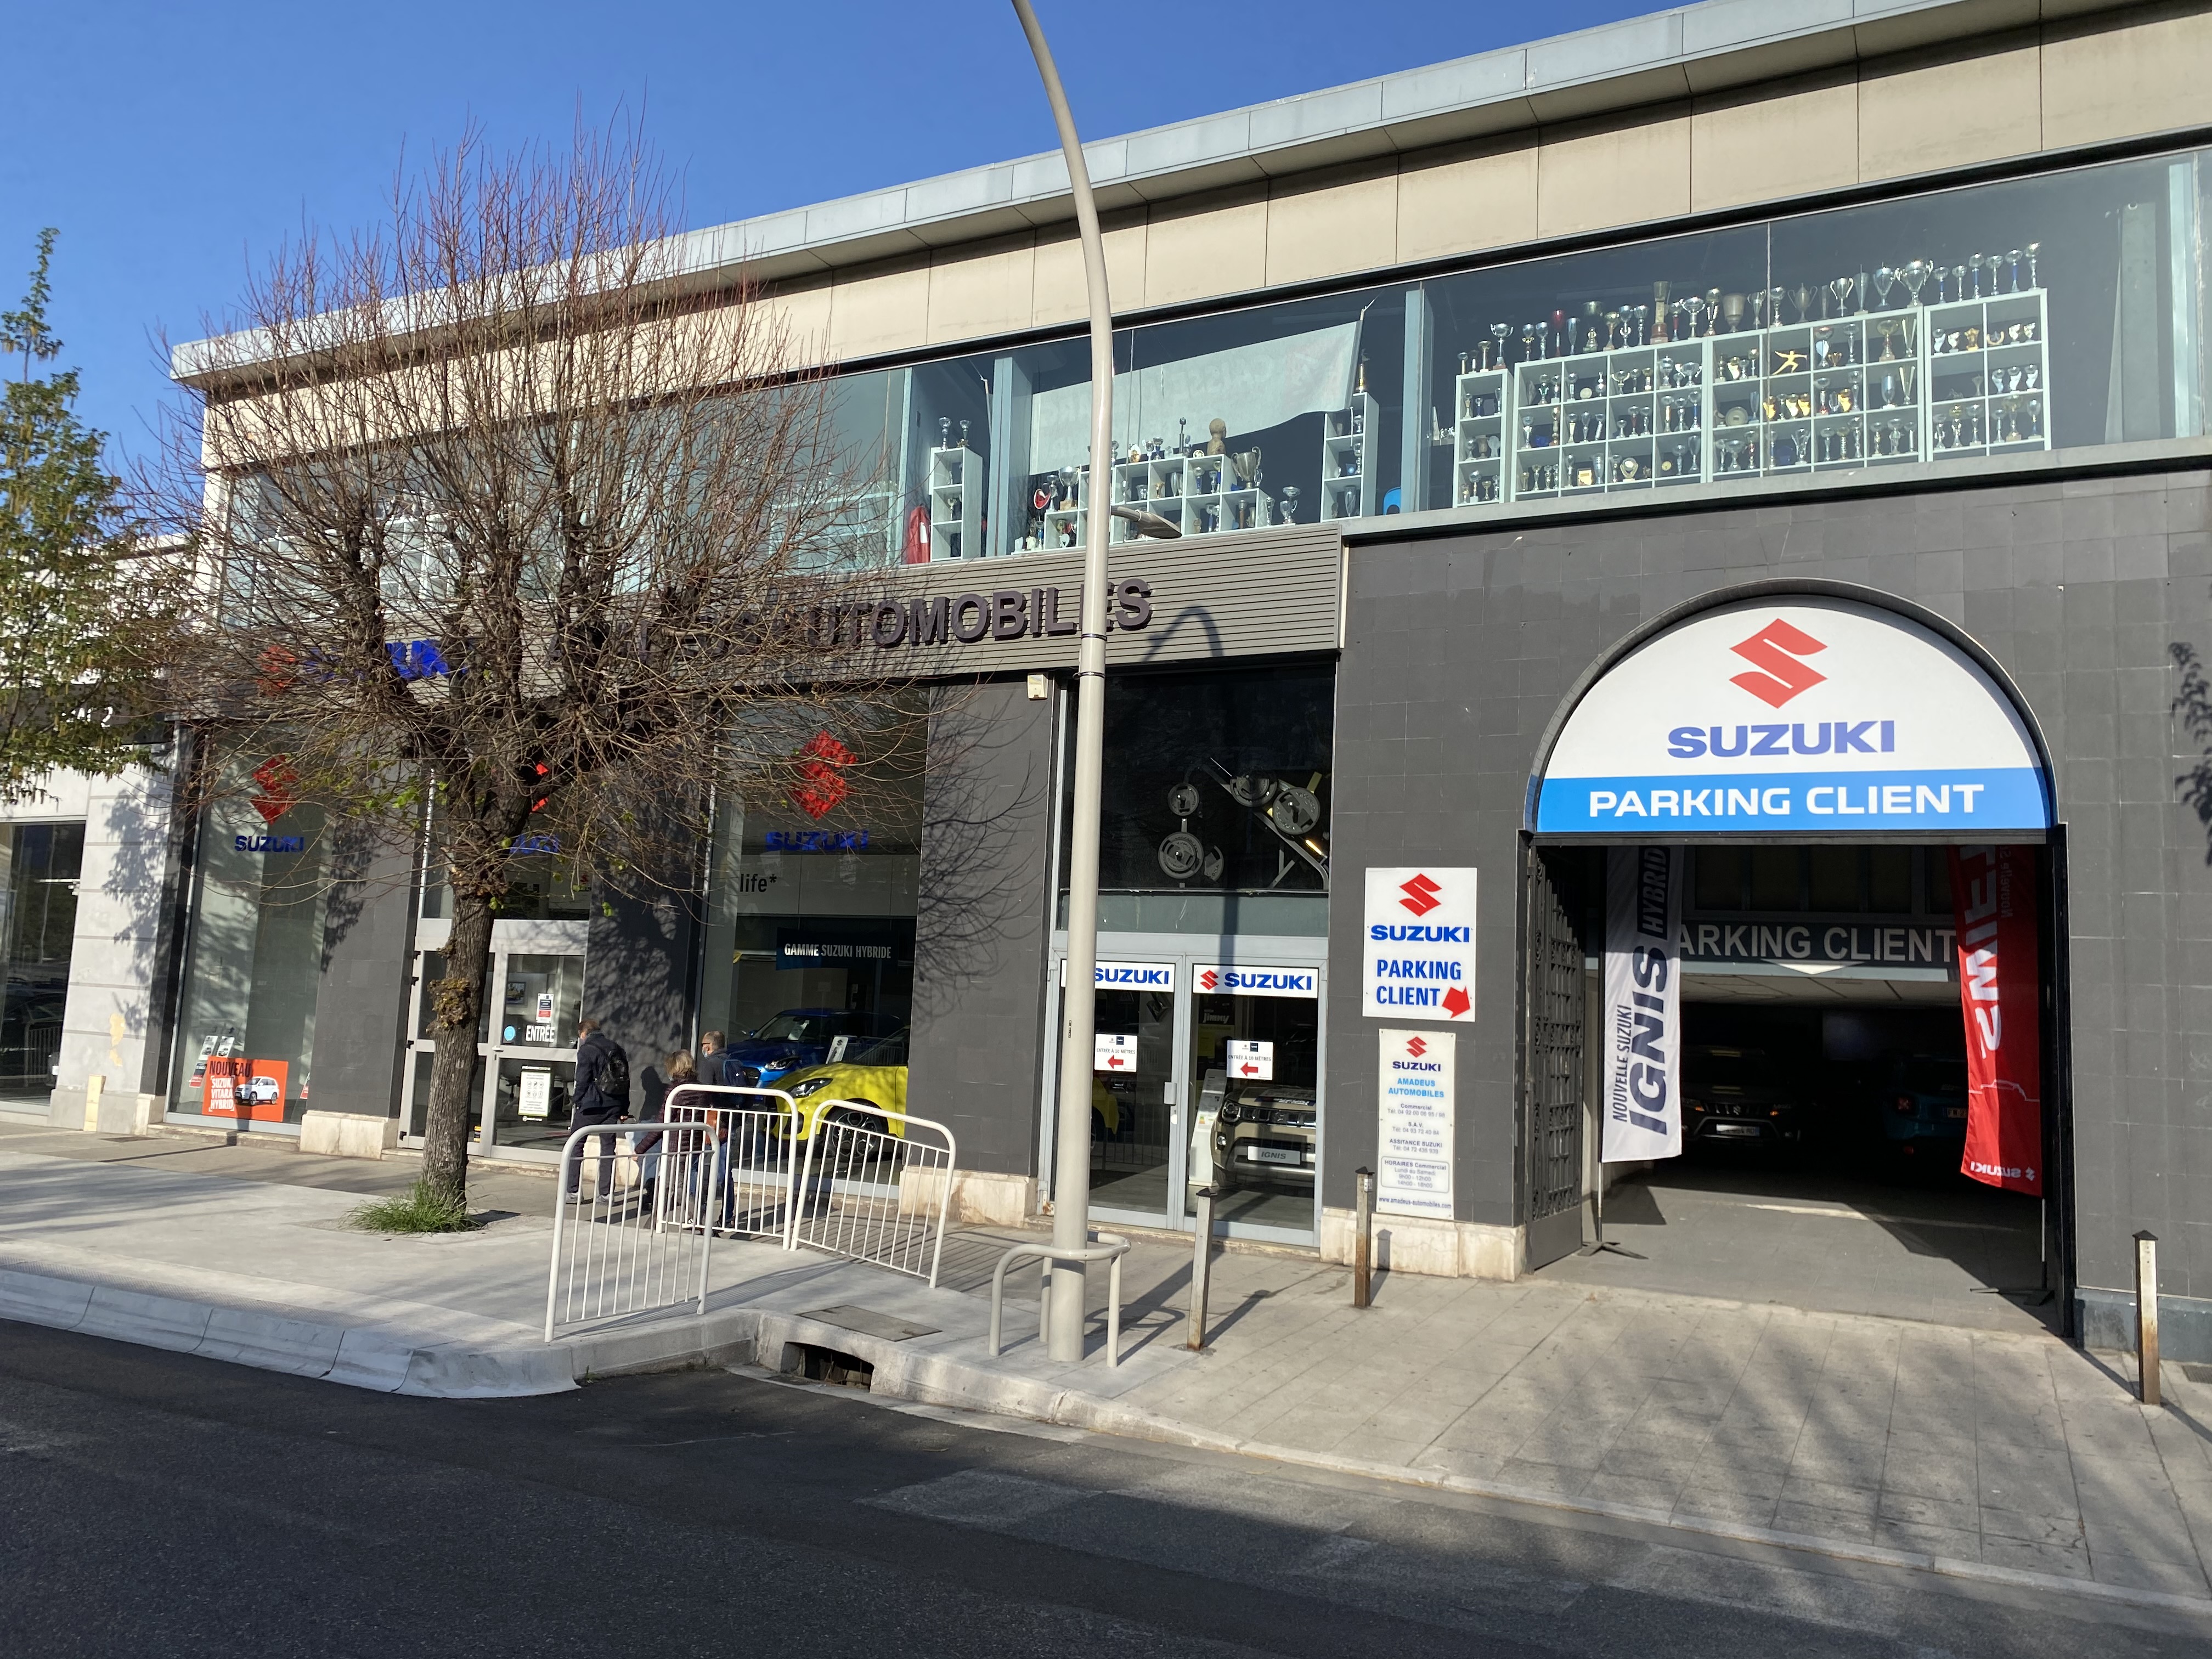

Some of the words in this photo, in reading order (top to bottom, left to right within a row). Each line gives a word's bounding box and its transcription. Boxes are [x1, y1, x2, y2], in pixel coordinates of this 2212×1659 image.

[771, 578, 1152, 650] UTOMOBILS
[1667, 720, 1895, 758] SUZUKI
[1589, 788, 1791, 818] PARKING
[1806, 784, 1984, 815] CLIENT
[235, 835, 303, 853] SUZUKI
[765, 831, 868, 850] SUZUKI
[1642, 848, 1667, 933] HYBRID
[1370, 925, 1469, 943] SUZUKI
[784, 944, 819, 956] GAMME
[821, 945, 852, 957] SUZUKI
[855, 946, 891, 958] HYBRIDE
[1680, 924, 1810, 958] ARKING
[1824, 927, 1956, 963] CLIENT
[1094, 967, 1169, 985] SUZUKI
[1376, 960, 1462, 980] PARKING
[1224, 973, 1312, 990] SUZUKI
[1376, 986, 1441, 1007] CLIENT
[526, 1025, 555, 1042] ENTRÉE
[1617, 1005, 1632, 1054] SUZUKI
[1630, 946, 1669, 1136] IGNIS
[209, 1060, 252, 1077] NOUVEAU
[1392, 1062, 1441, 1071] SUZUKI
[212, 1078, 234, 1088] SUZUKI
[1397, 1078, 1435, 1086] AMADEUS
[1613, 1057, 1629, 1123] NOUVELLE
[211, 1088, 233, 1099] VITARA
[1388, 1088, 1444, 1098] AUTOMOBILES
[211, 1099, 233, 1110] HYBRID
[1261, 1150, 1286, 1160] IGNIS
[1379, 1197, 1451, 1209] www.amadeus-automobiles.com
